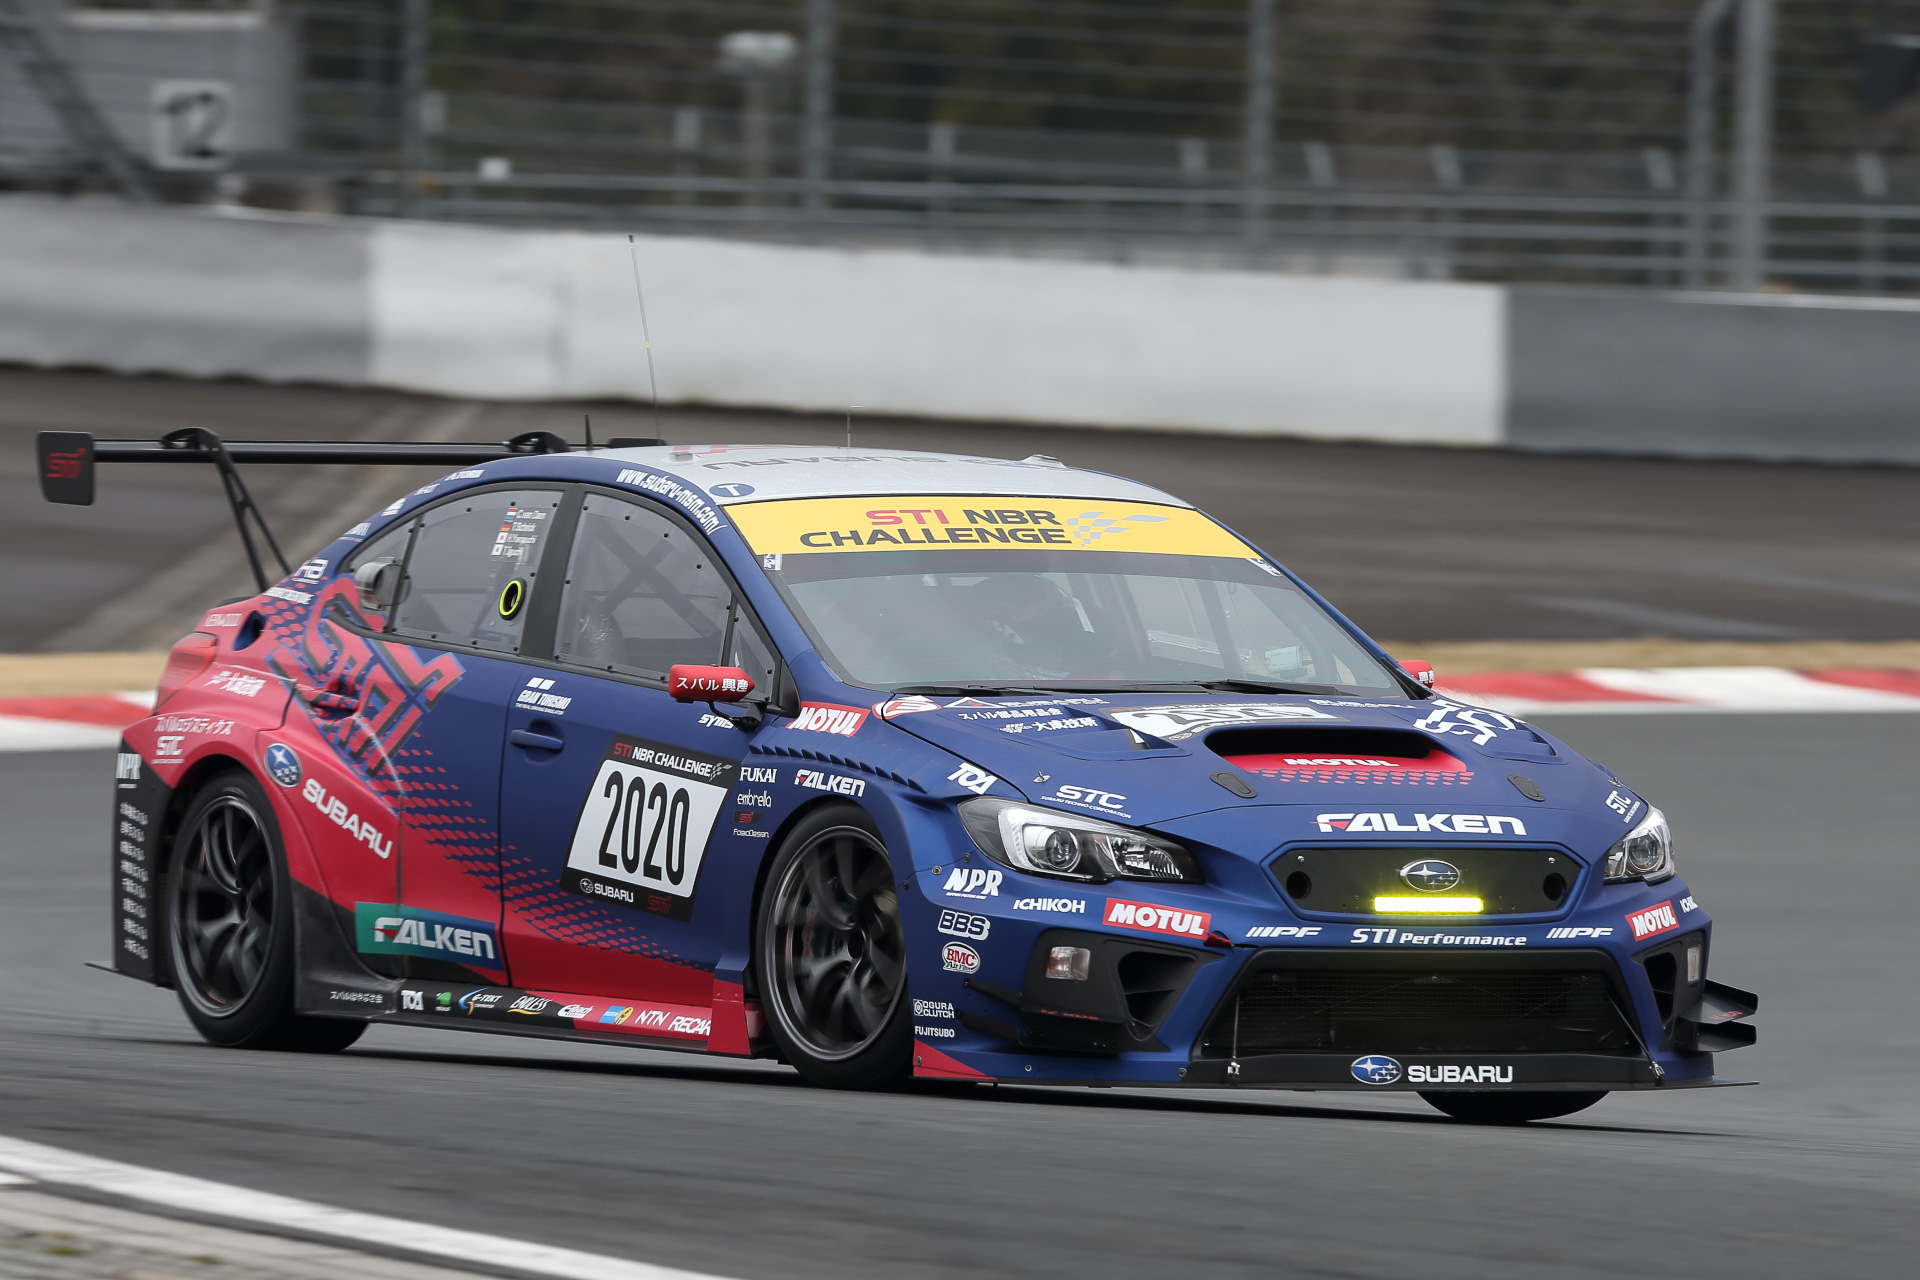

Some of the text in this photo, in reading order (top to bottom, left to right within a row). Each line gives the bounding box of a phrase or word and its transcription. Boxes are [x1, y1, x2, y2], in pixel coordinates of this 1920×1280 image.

[865, 509, 1063, 526] STI NBR
[800, 527, 1072, 548] CHALLENGE
[517, 689, 542, 704] GRAN
[537, 692, 572, 710] TURISMO
[795, 706, 863, 736] MOTUL
[613, 743, 713, 777] STI NBR CHALLENGE
[1283, 757, 1399, 767] MOTUL
[739, 767, 778, 783] FUKAI
[794, 769, 866, 797] FALKEN
[947, 761, 999, 795] TOA
[1056, 784, 1127, 810] STC
[1605, 790, 1632, 815] STC
[302, 778, 393, 859] SUBARU
[598, 770, 690, 886] 2020
[1314, 813, 1528, 836] FALKEN
[594, 882, 634, 903] SUBARU
[942, 867, 1003, 897] NPR
[1013, 898, 1086, 914] ICHIKOH
[938, 910, 990, 940] BBS
[1108, 902, 1205, 936] MOTUL
[1631, 905, 1676, 937] MOTUL
[373, 916, 495, 959] FALKEN
[1350, 928, 1527, 946] STI Performance
[946, 948, 975, 967] BMC
[400, 989, 425, 1011] TOA
[510, 995, 552, 1011] ENDLESS
[922, 1000, 954, 1011] OGURA
[635, 1009, 670, 1027] NTN
[922, 1008, 955, 1018] CLUTCH
[914, 1025, 955, 1038] FUJITSUBO
[1407, 1065, 1513, 1084] SUBARU
